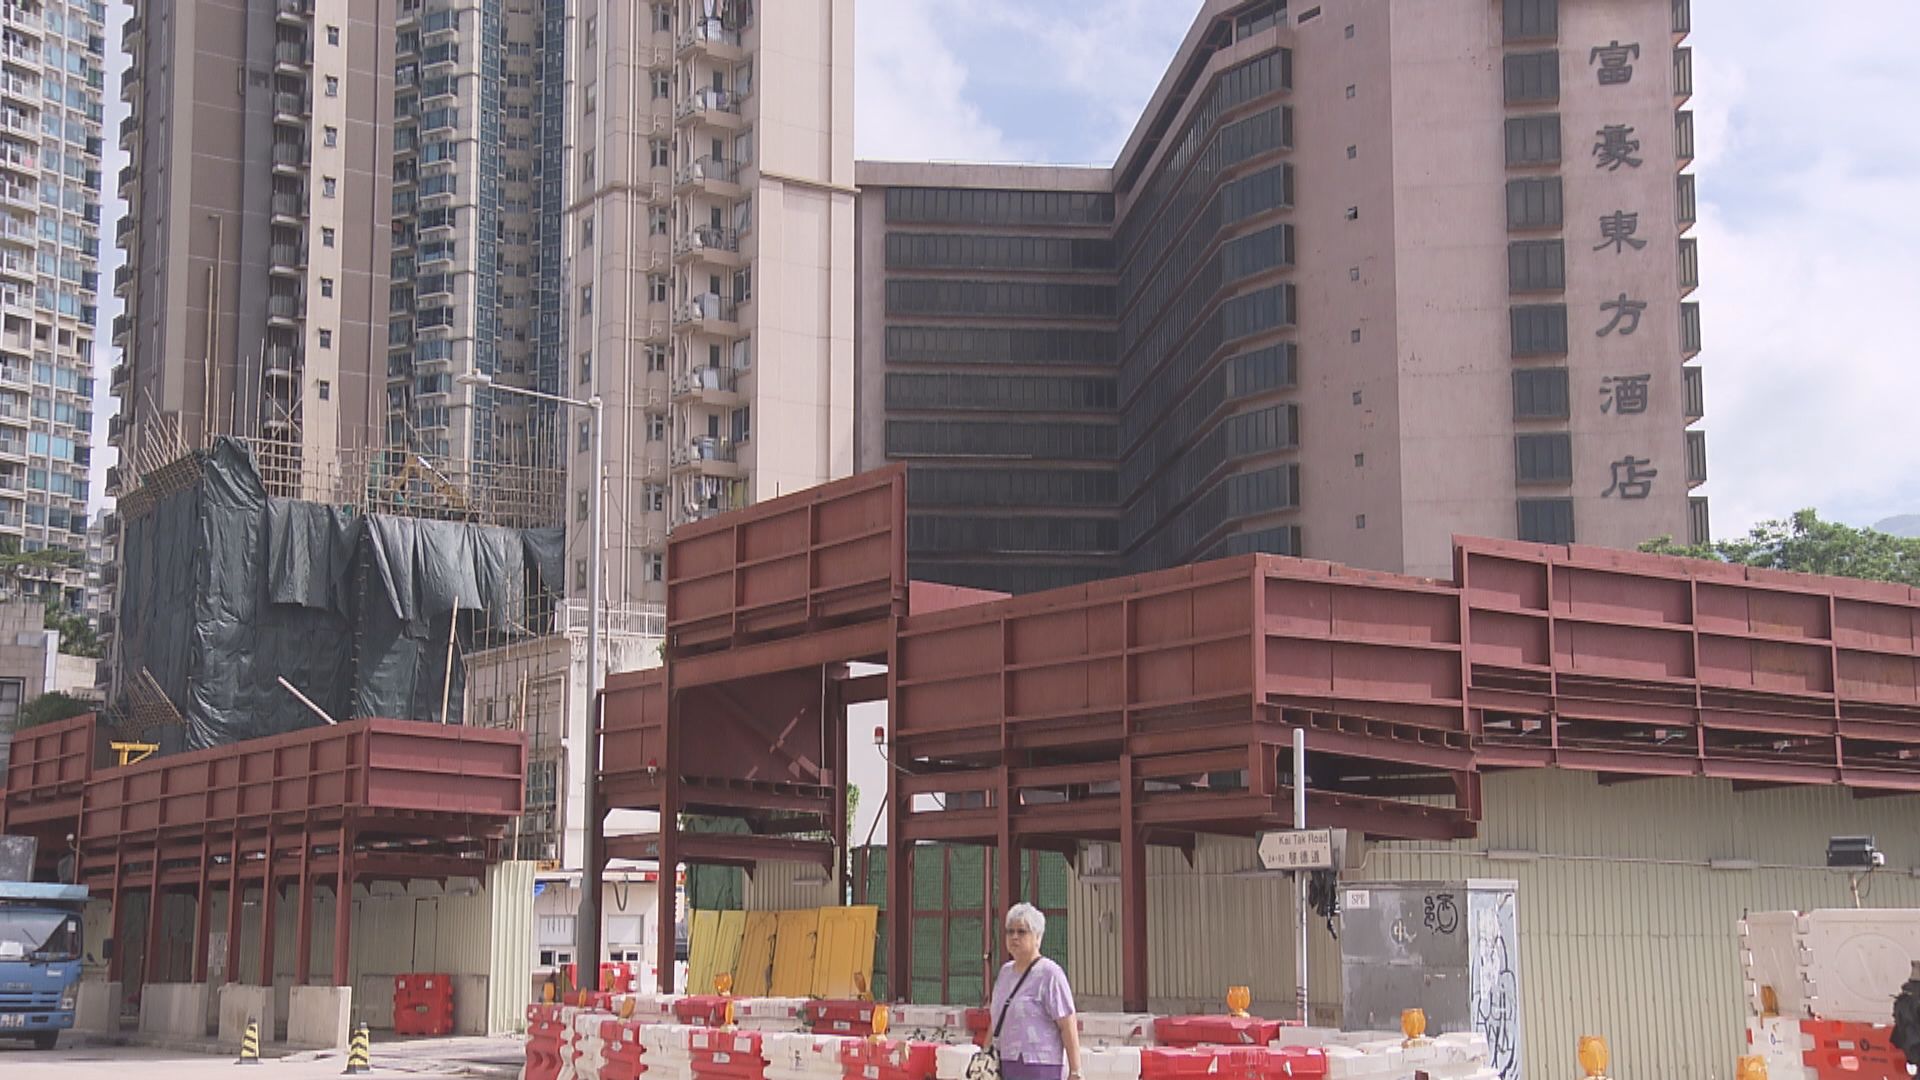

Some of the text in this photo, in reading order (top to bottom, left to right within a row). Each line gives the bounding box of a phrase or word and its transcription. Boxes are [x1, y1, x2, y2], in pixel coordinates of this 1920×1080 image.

[1589, 41, 1657, 499] 富豪東方酒店
[1279, 832, 1328, 845] Kai Tak Road
